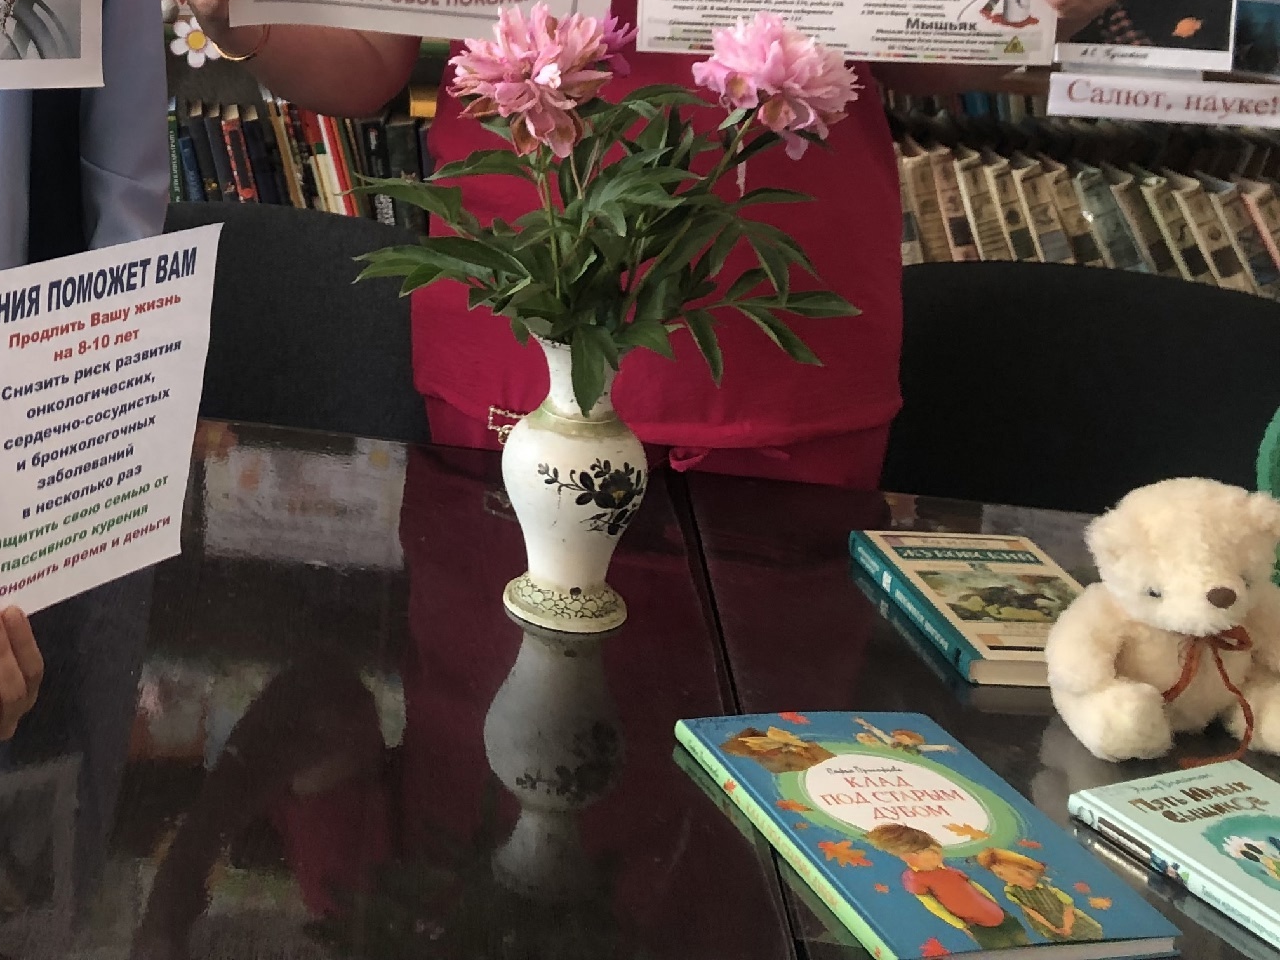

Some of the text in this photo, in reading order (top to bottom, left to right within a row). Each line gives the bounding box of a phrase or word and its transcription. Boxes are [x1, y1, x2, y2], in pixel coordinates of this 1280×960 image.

[905, 18, 978, 33] Мышьяк
[1068, 79, 1280, 116] Салют, науке!
[48, 258, 151, 312] ПОМОЖЕТ
[156, 247, 197, 284] ВАМ
[9, 295, 181, 349] Продлить Вашу жизнь
[54, 329, 139, 361] на 8-10 лет
[2, 341, 181, 400] Снизить риск развития
[4, 389, 170, 450] сердечно-сосудистых
[27, 373, 155, 418] онкологических,
[17, 415, 155, 472] и бронхолегочных
[37, 443, 133, 489] заболеваний
[23, 465, 142, 519] в несколько раз
[63, 503, 100, 525] свою
[105, 483, 150, 509] семью
[154, 476, 168, 488] от
[1, 504, 148, 572] пассивного курения
[63, 542, 107, 570] время
[111, 536, 120, 549] и
[122, 514, 172, 547] деньги
[819, 789, 966, 806] ПОД СТАРЫМ
[844, 775, 914, 788] КЛАД
[873, 805, 952, 821] ДУБОМ
